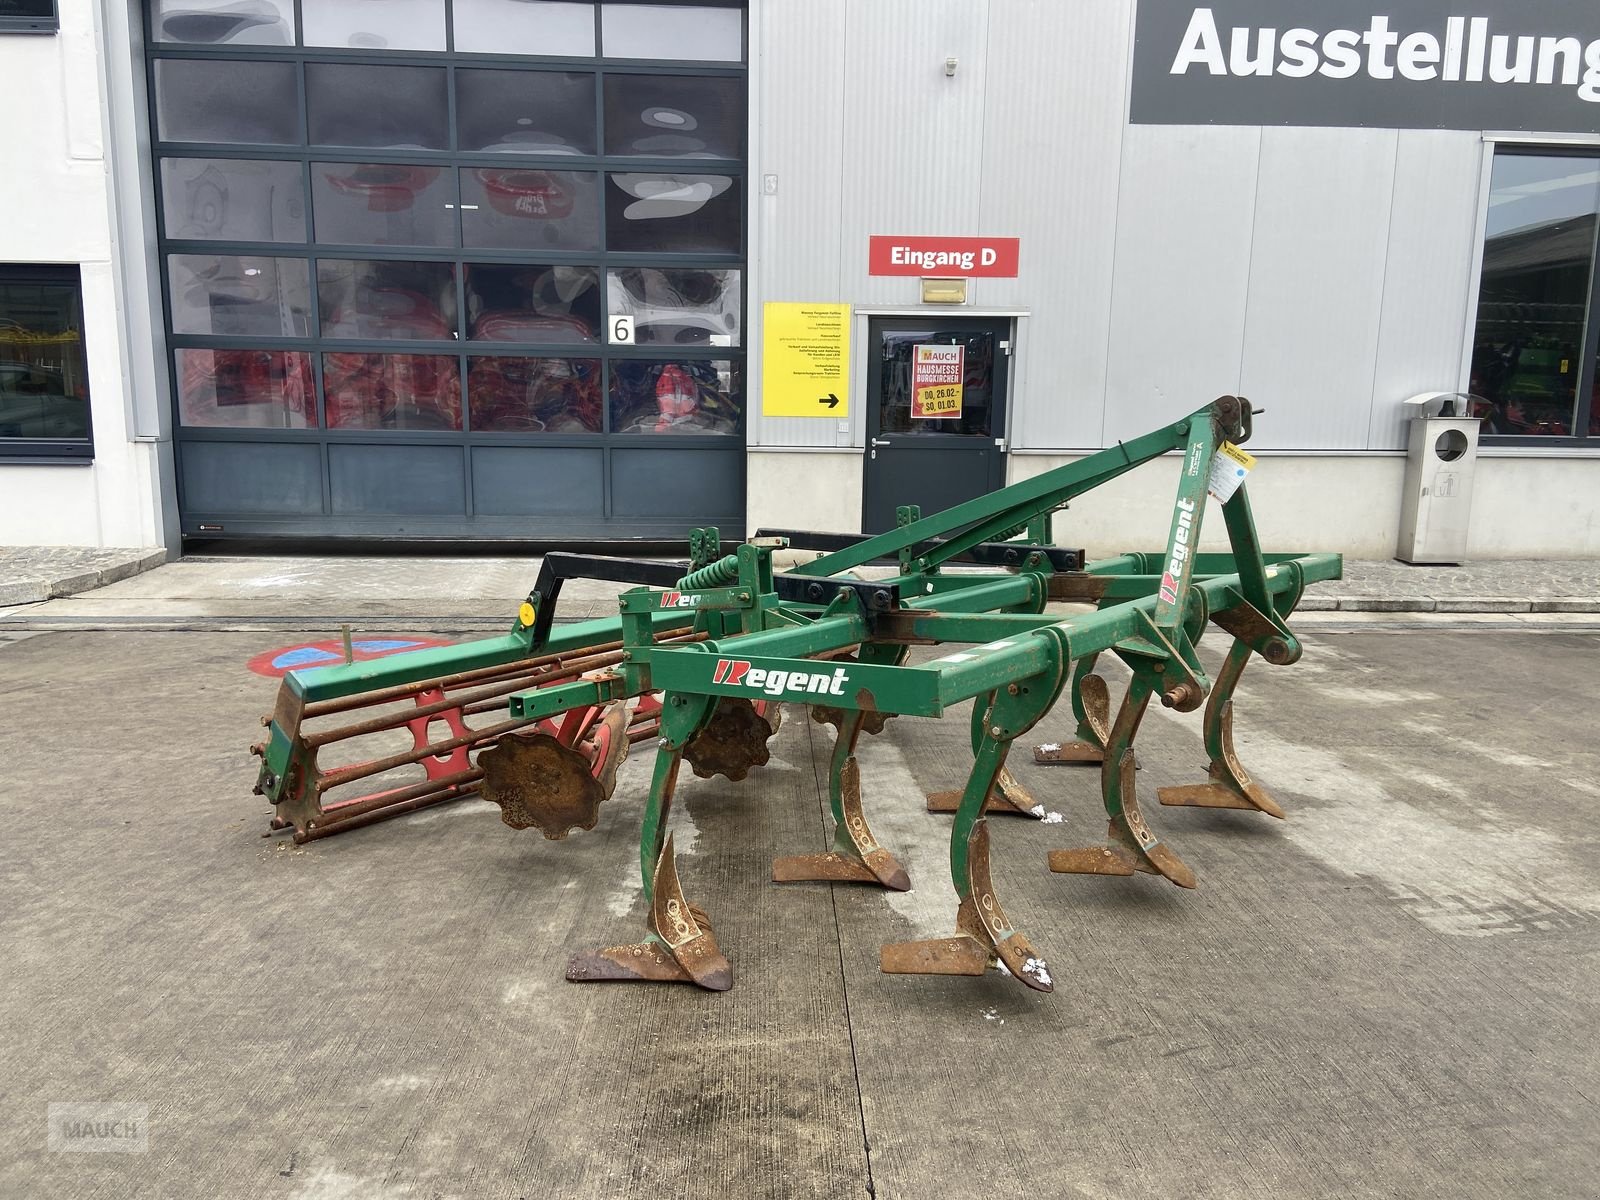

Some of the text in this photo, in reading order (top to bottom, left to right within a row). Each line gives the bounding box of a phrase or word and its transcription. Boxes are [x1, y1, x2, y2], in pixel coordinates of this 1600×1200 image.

[891, 246, 997, 270] Eingang D
[614, 318, 629, 341] 6
[923, 352, 957, 361] MAUCH
[917, 364, 959, 375] HAUSMESSE
[917, 374, 959, 383] BURGKIRCHEN
[1160, 497, 1195, 605] Regent
[712, 659, 850, 696] Regent
